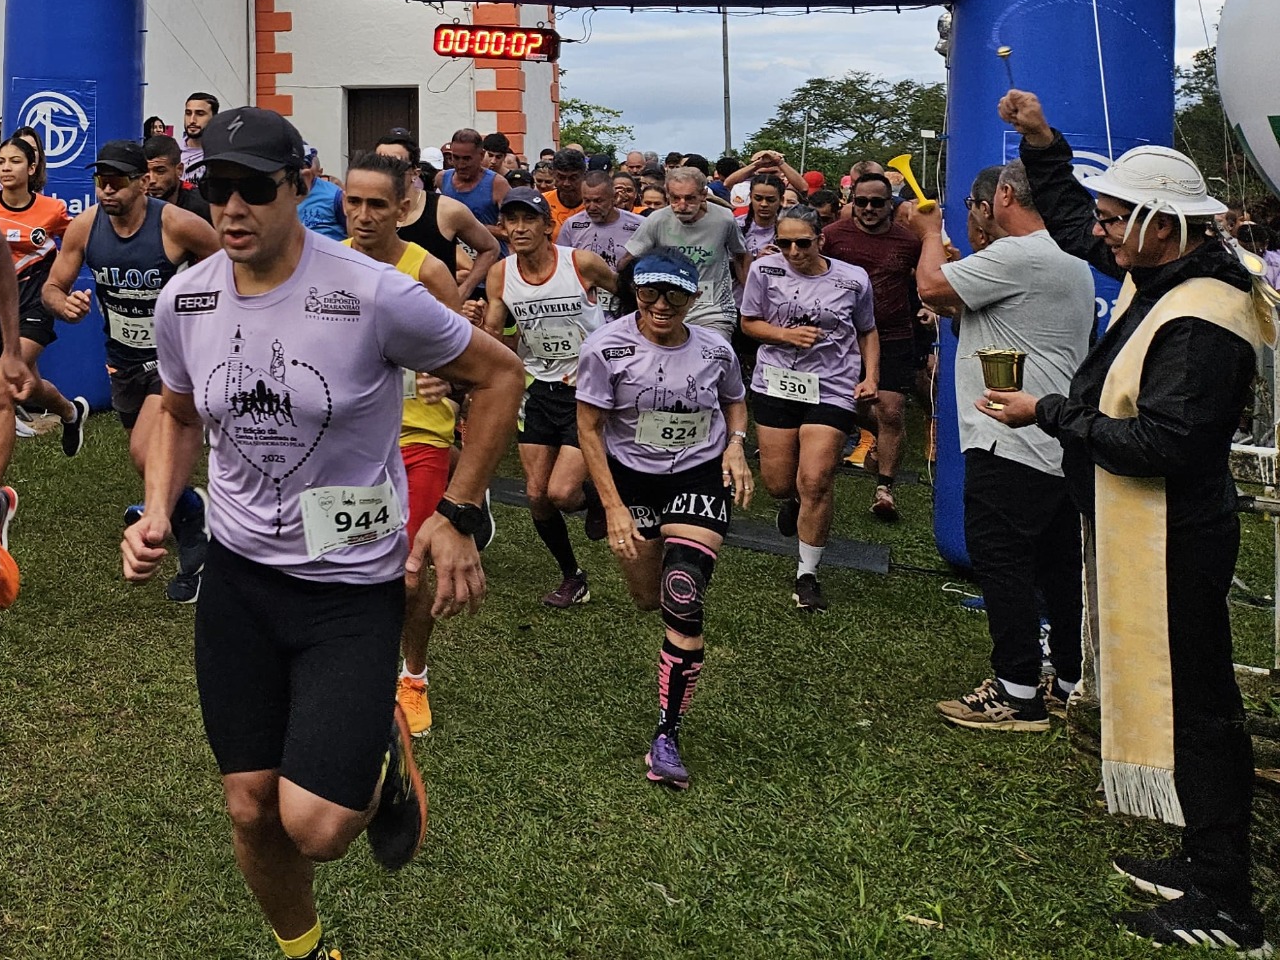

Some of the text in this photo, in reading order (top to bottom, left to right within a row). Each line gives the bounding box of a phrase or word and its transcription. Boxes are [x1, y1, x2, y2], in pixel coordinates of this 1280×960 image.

[439, 29, 542, 57] 00:00:02
[528, 302, 582, 316] CAVEIRAS
[122, 327, 151, 341] 872
[542, 340, 572, 353] 878
[779, 380, 807, 395] 530
[661, 426, 697, 441] 824
[261, 454, 286, 464] 2025
[334, 505, 390, 533] 944
